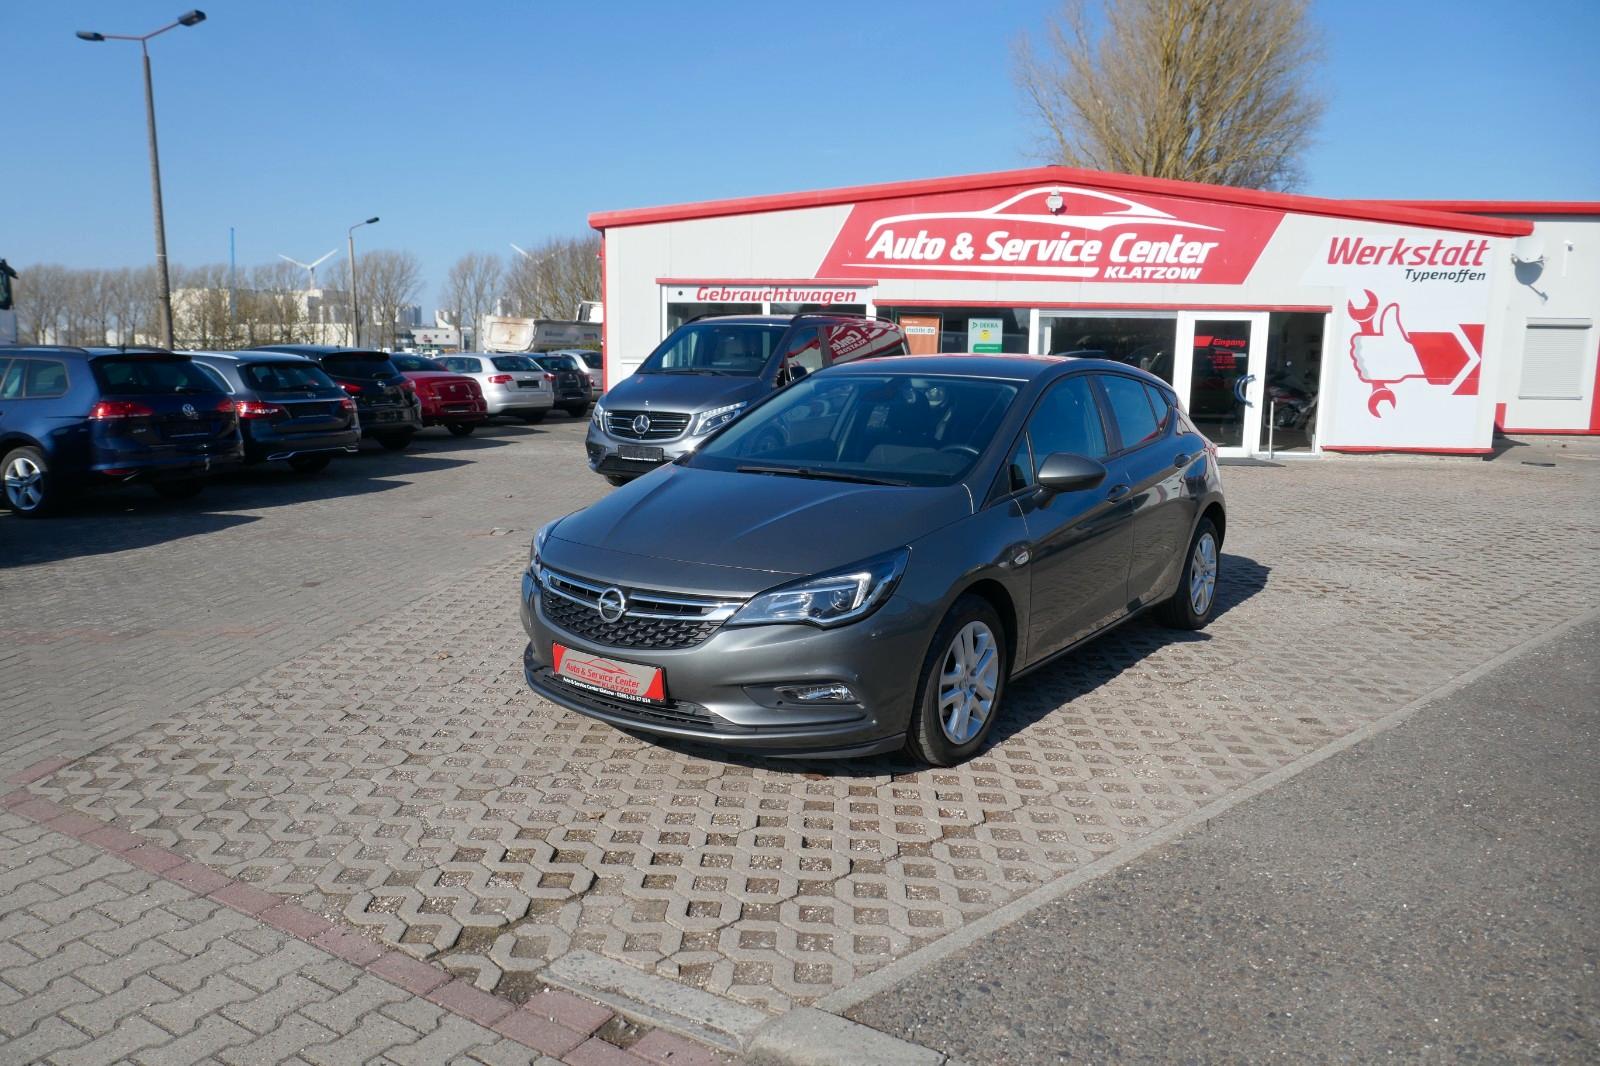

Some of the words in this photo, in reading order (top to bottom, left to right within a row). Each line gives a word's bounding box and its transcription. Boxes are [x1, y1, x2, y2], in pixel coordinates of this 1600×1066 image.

[866, 230, 946, 260] Auto
[949, 232, 975, 261] &
[980, 230, 1102, 264] Service
[1108, 232, 1220, 265] Center
[1327, 236, 1491, 267] Werkstatt
[1104, 266, 1203, 280] KLATZOW
[1405, 268, 1487, 283] Typenoffen
[696, 286, 857, 308] Gebrauchtwagen
[1213, 338, 1247, 348] Eingang
[566, 662, 580, 674] Auto
[580, 667, 587, 676] &
[588, 669, 613, 683] Service
[615, 676, 640, 689] Center
